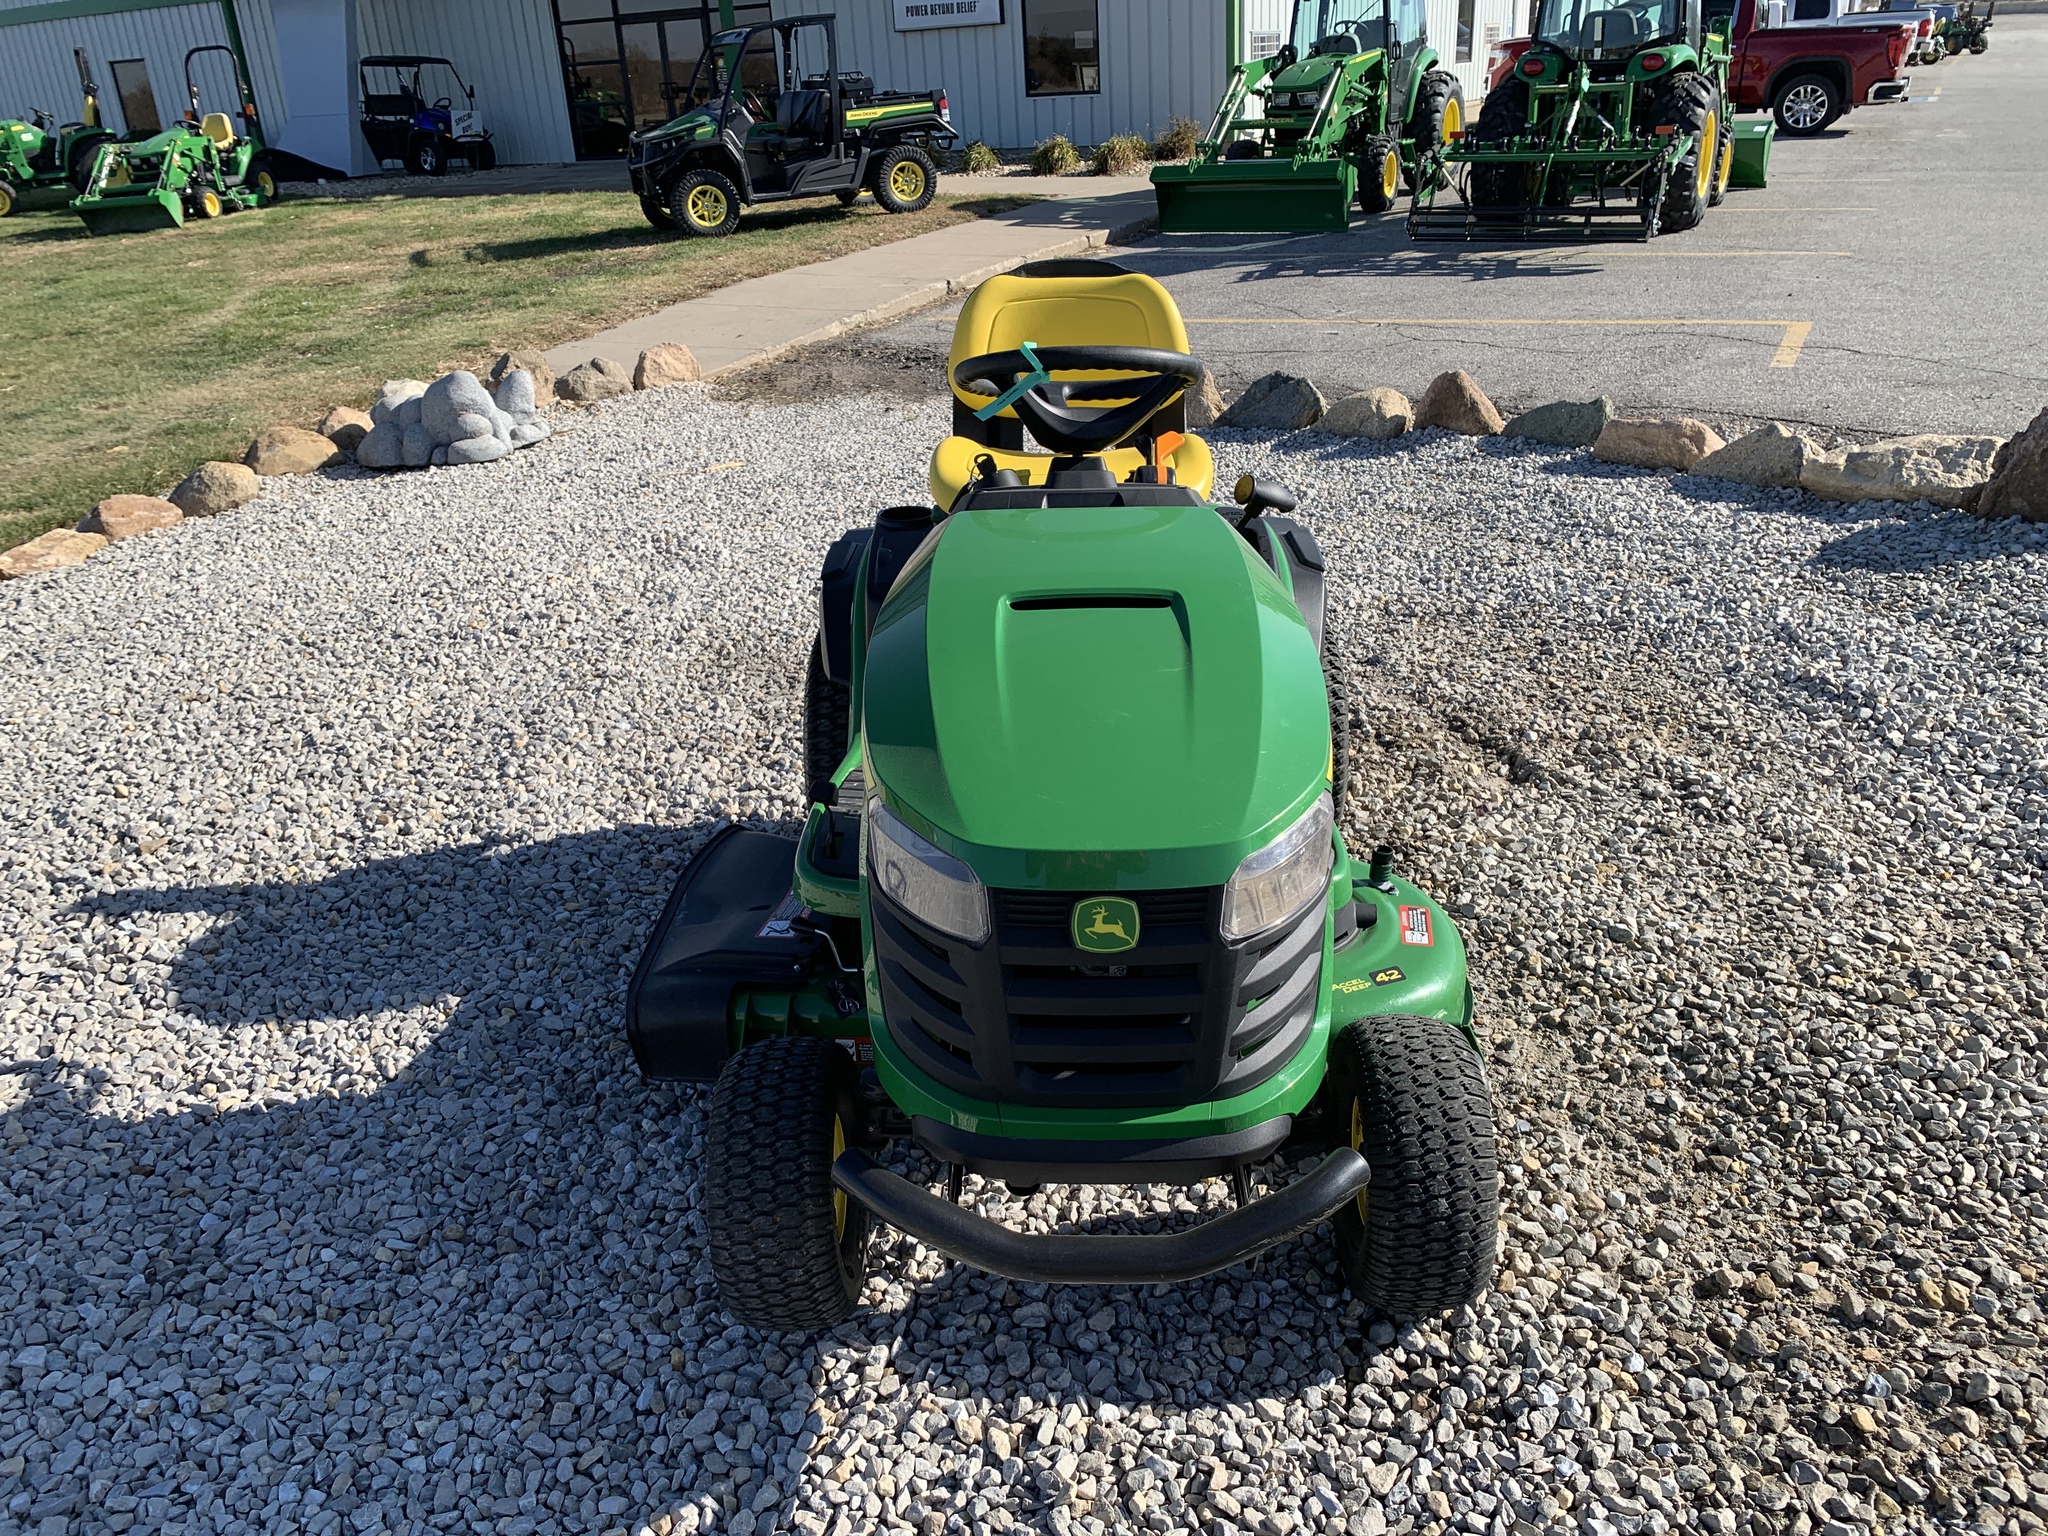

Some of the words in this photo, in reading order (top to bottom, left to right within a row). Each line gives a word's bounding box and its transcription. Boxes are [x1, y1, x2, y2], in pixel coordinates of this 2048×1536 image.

[905, 5, 928, 17] POWER
[930, 3, 954, 15] BEYOND
[956, 1, 977, 14] BELIEF
[455, 112, 473, 126] SPECIAL
[1375, 969, 1402, 982] 42
[1332, 978, 1365, 991] ACCEL
[1342, 981, 1372, 994] DEEP
